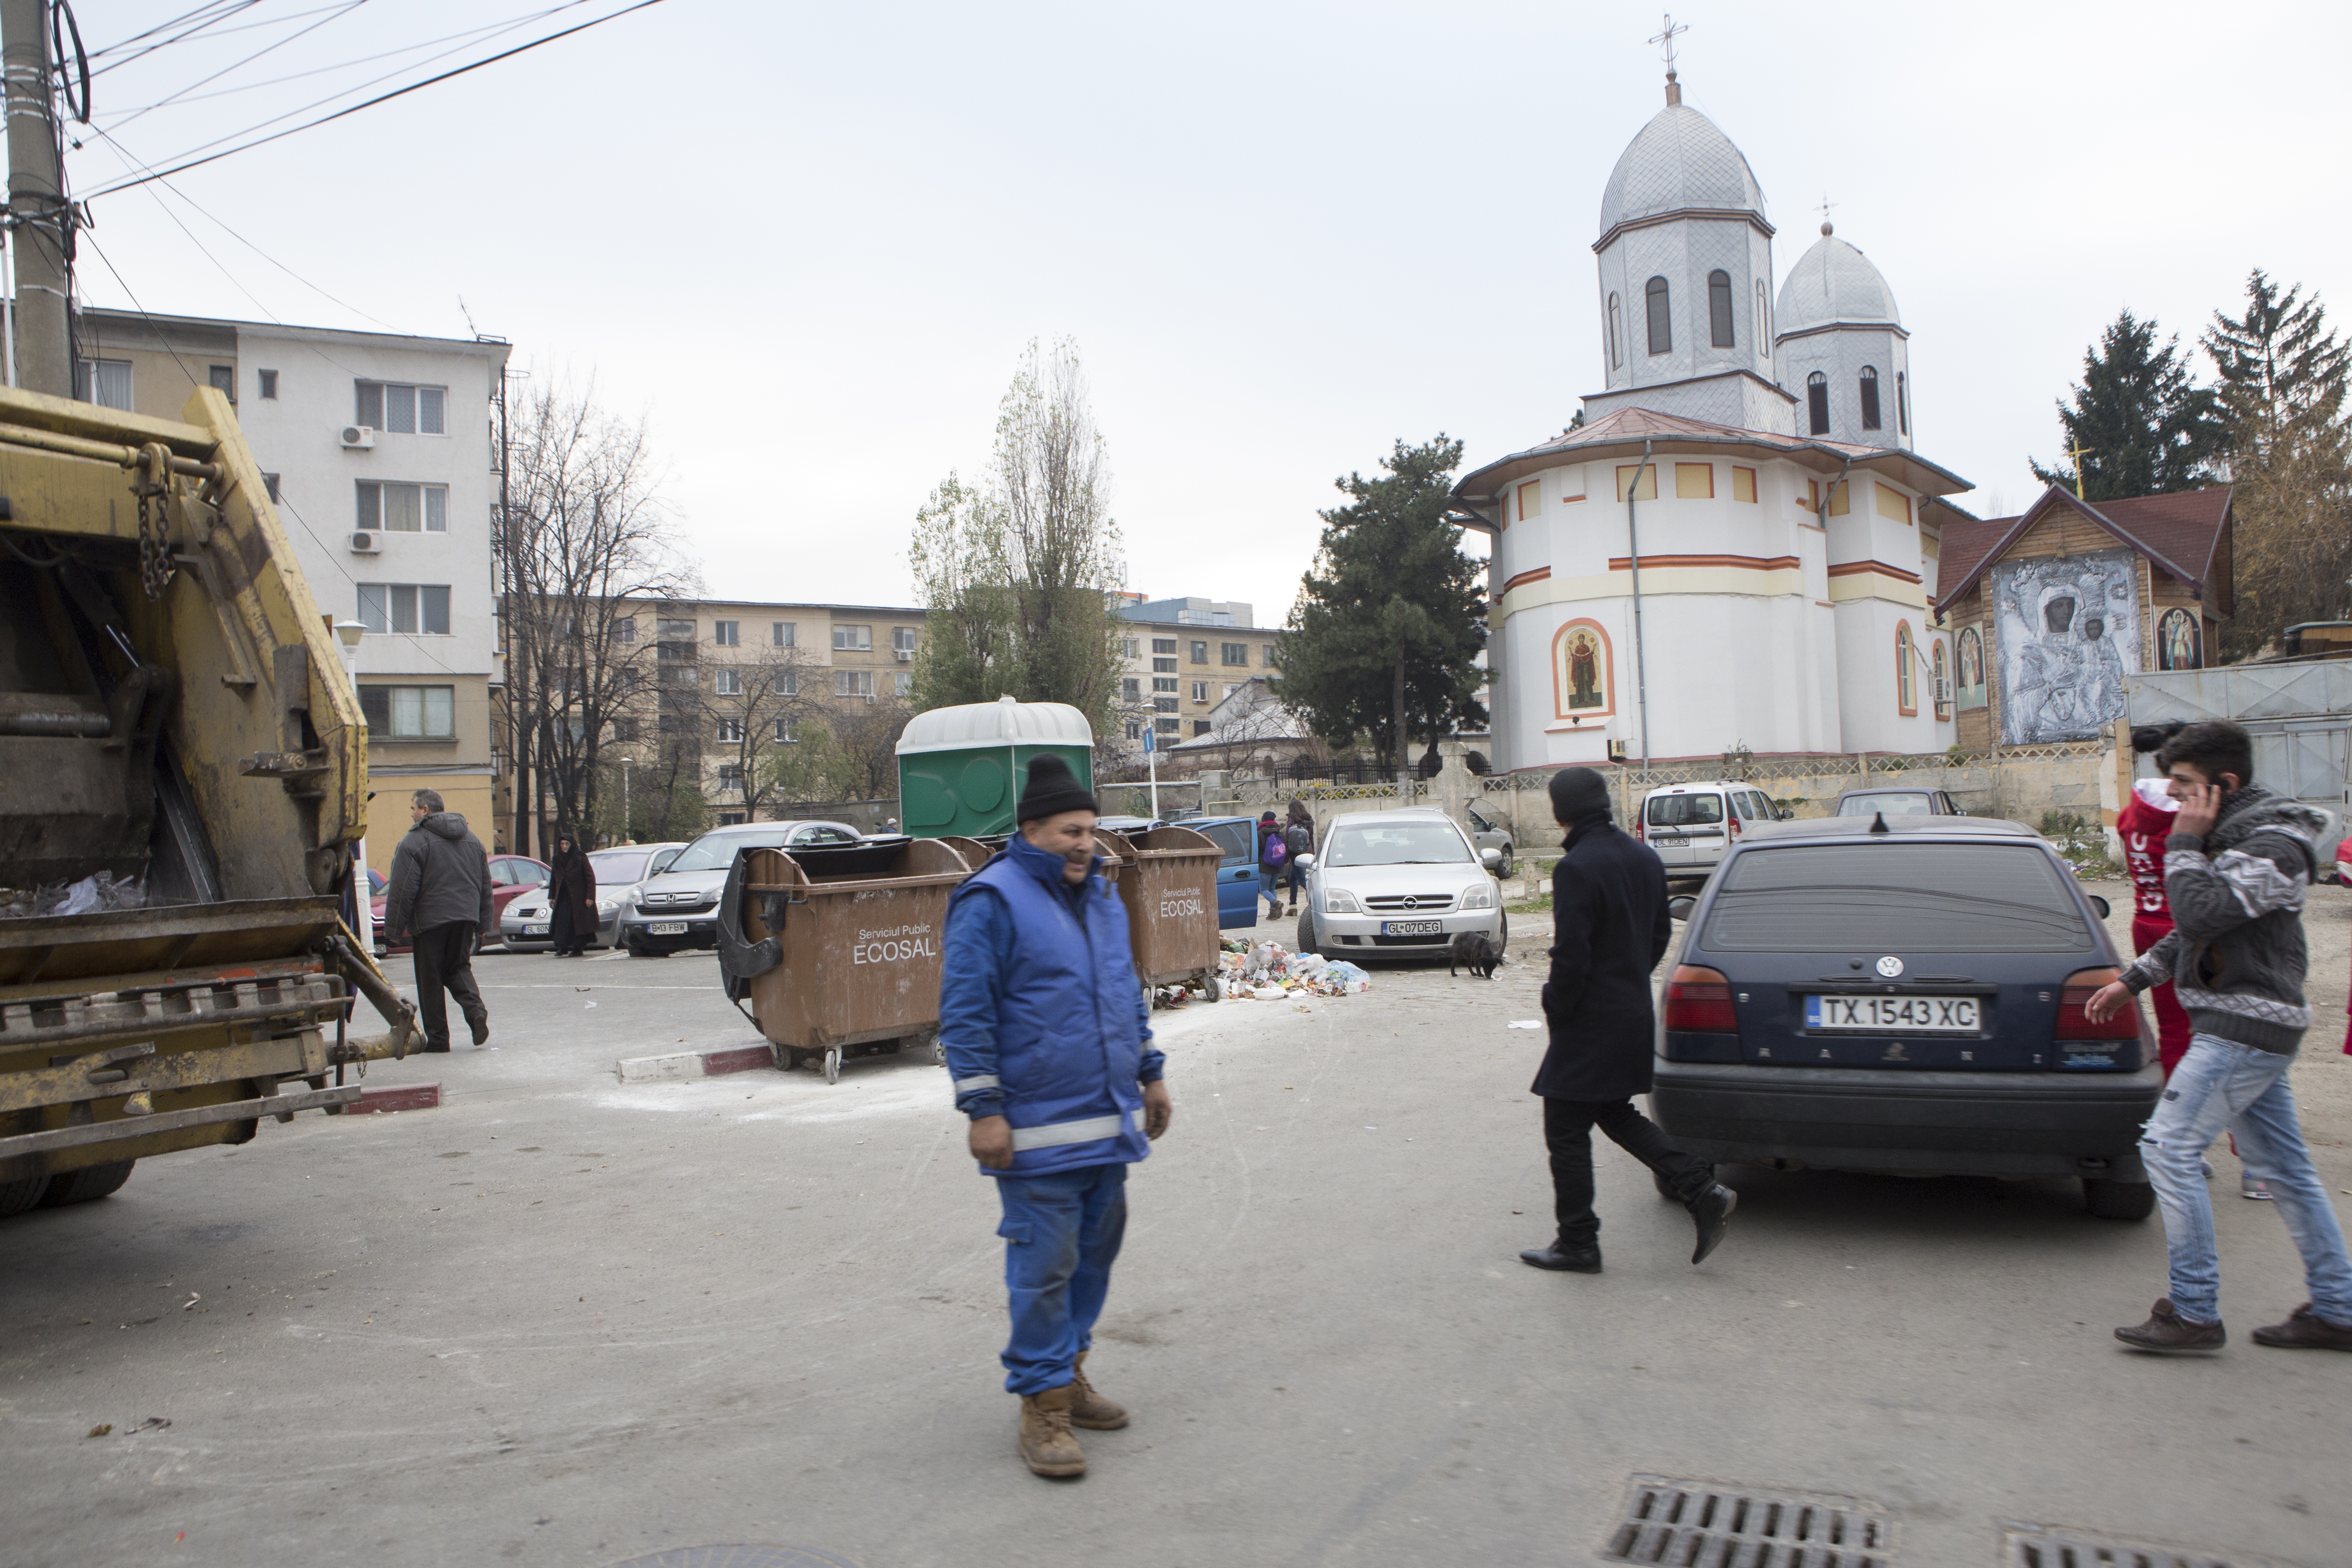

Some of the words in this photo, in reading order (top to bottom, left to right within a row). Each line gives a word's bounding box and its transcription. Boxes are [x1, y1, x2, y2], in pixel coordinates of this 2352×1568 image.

[1164, 888, 1186, 898] Serviciul
[1187, 887, 1200, 896] Public
[1161, 899, 1204, 918] ECOSAL
[859, 926, 900, 940] Serviciul
[903, 924, 931, 935] Public
[1389, 924, 1402, 933] GL
[1405, 922, 1439, 933] 07DEG
[854, 937, 936, 965] ECOSAL
[1825, 998, 1859, 1024] TX
[1868, 999, 1931, 1025] 1543
[1938, 1001, 1975, 1026] XC
